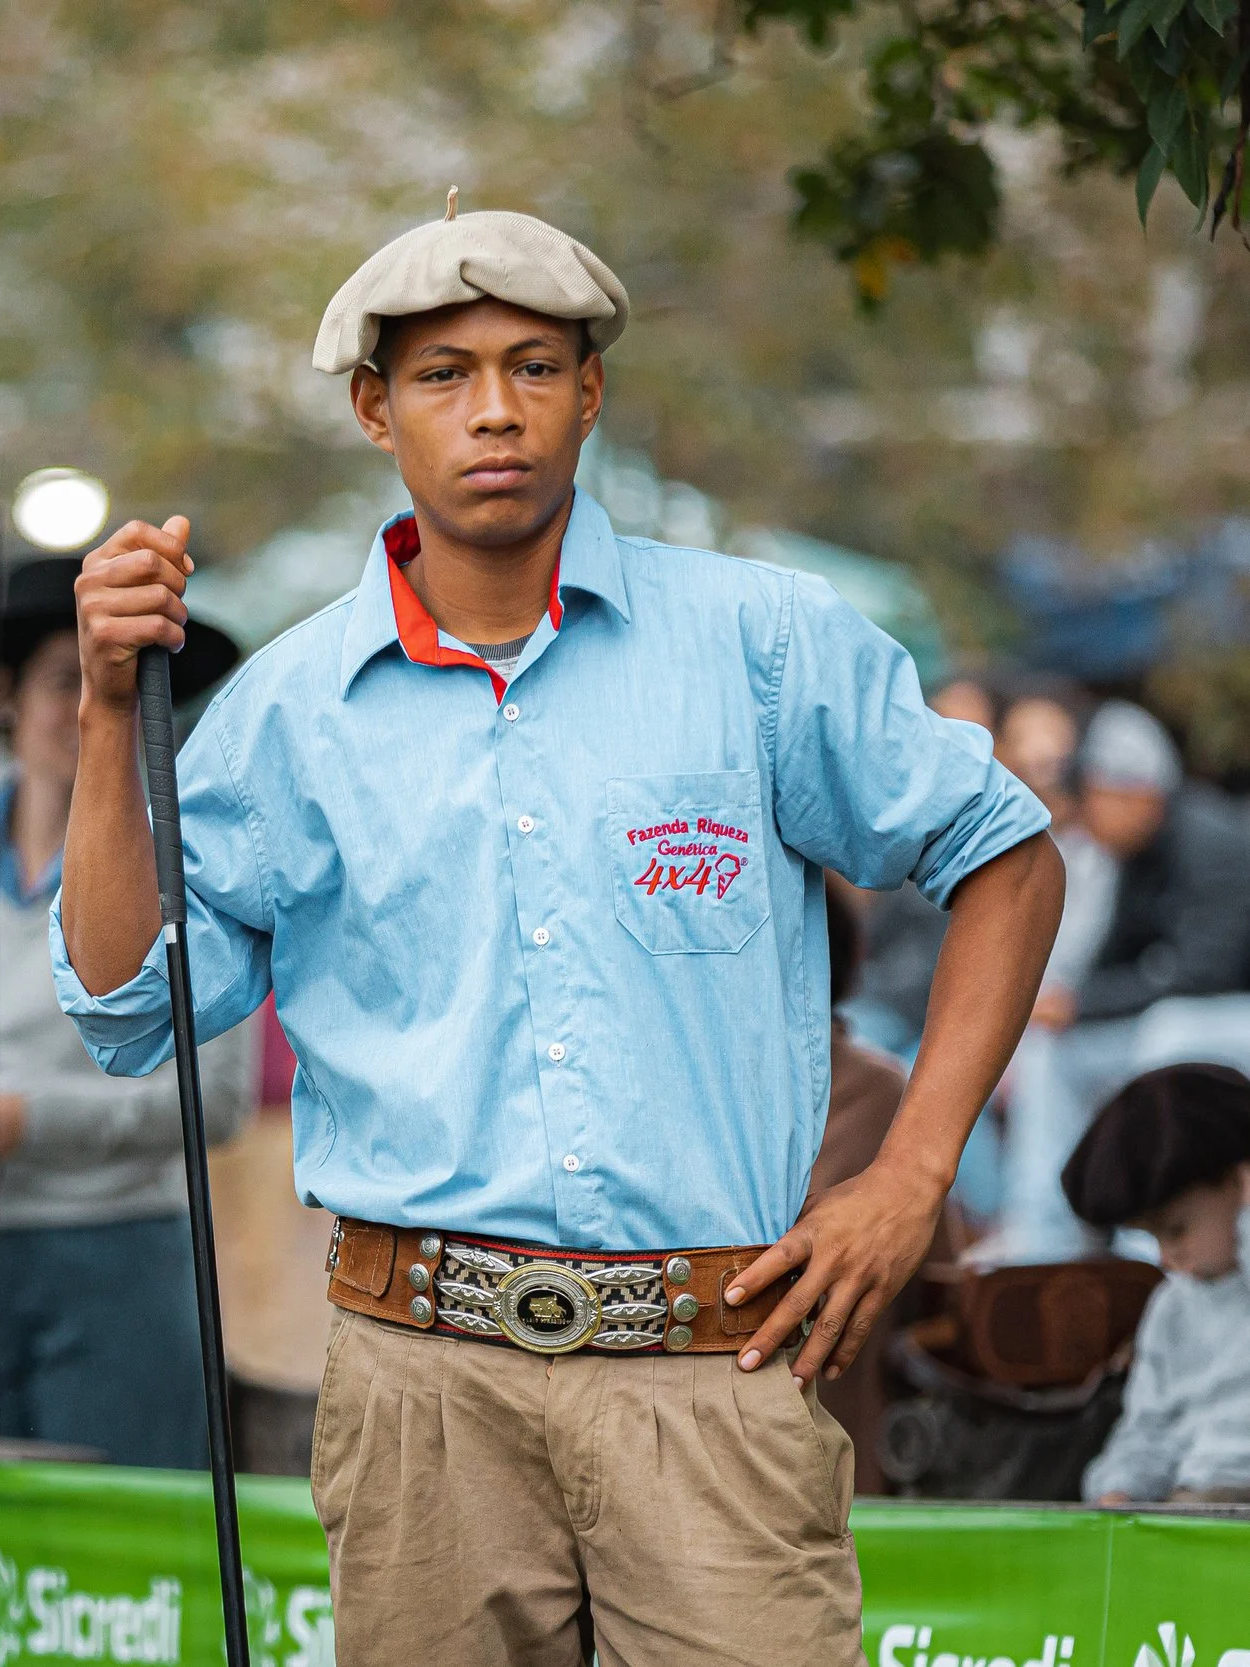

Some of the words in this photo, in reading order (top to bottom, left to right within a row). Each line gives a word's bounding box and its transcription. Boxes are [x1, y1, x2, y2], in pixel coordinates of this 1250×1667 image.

[626, 819, 689, 846] Fazenda
[696, 817, 749, 844] Riqueza
[657, 839, 718, 856] Genética
[634, 857, 712, 895] 4x4
